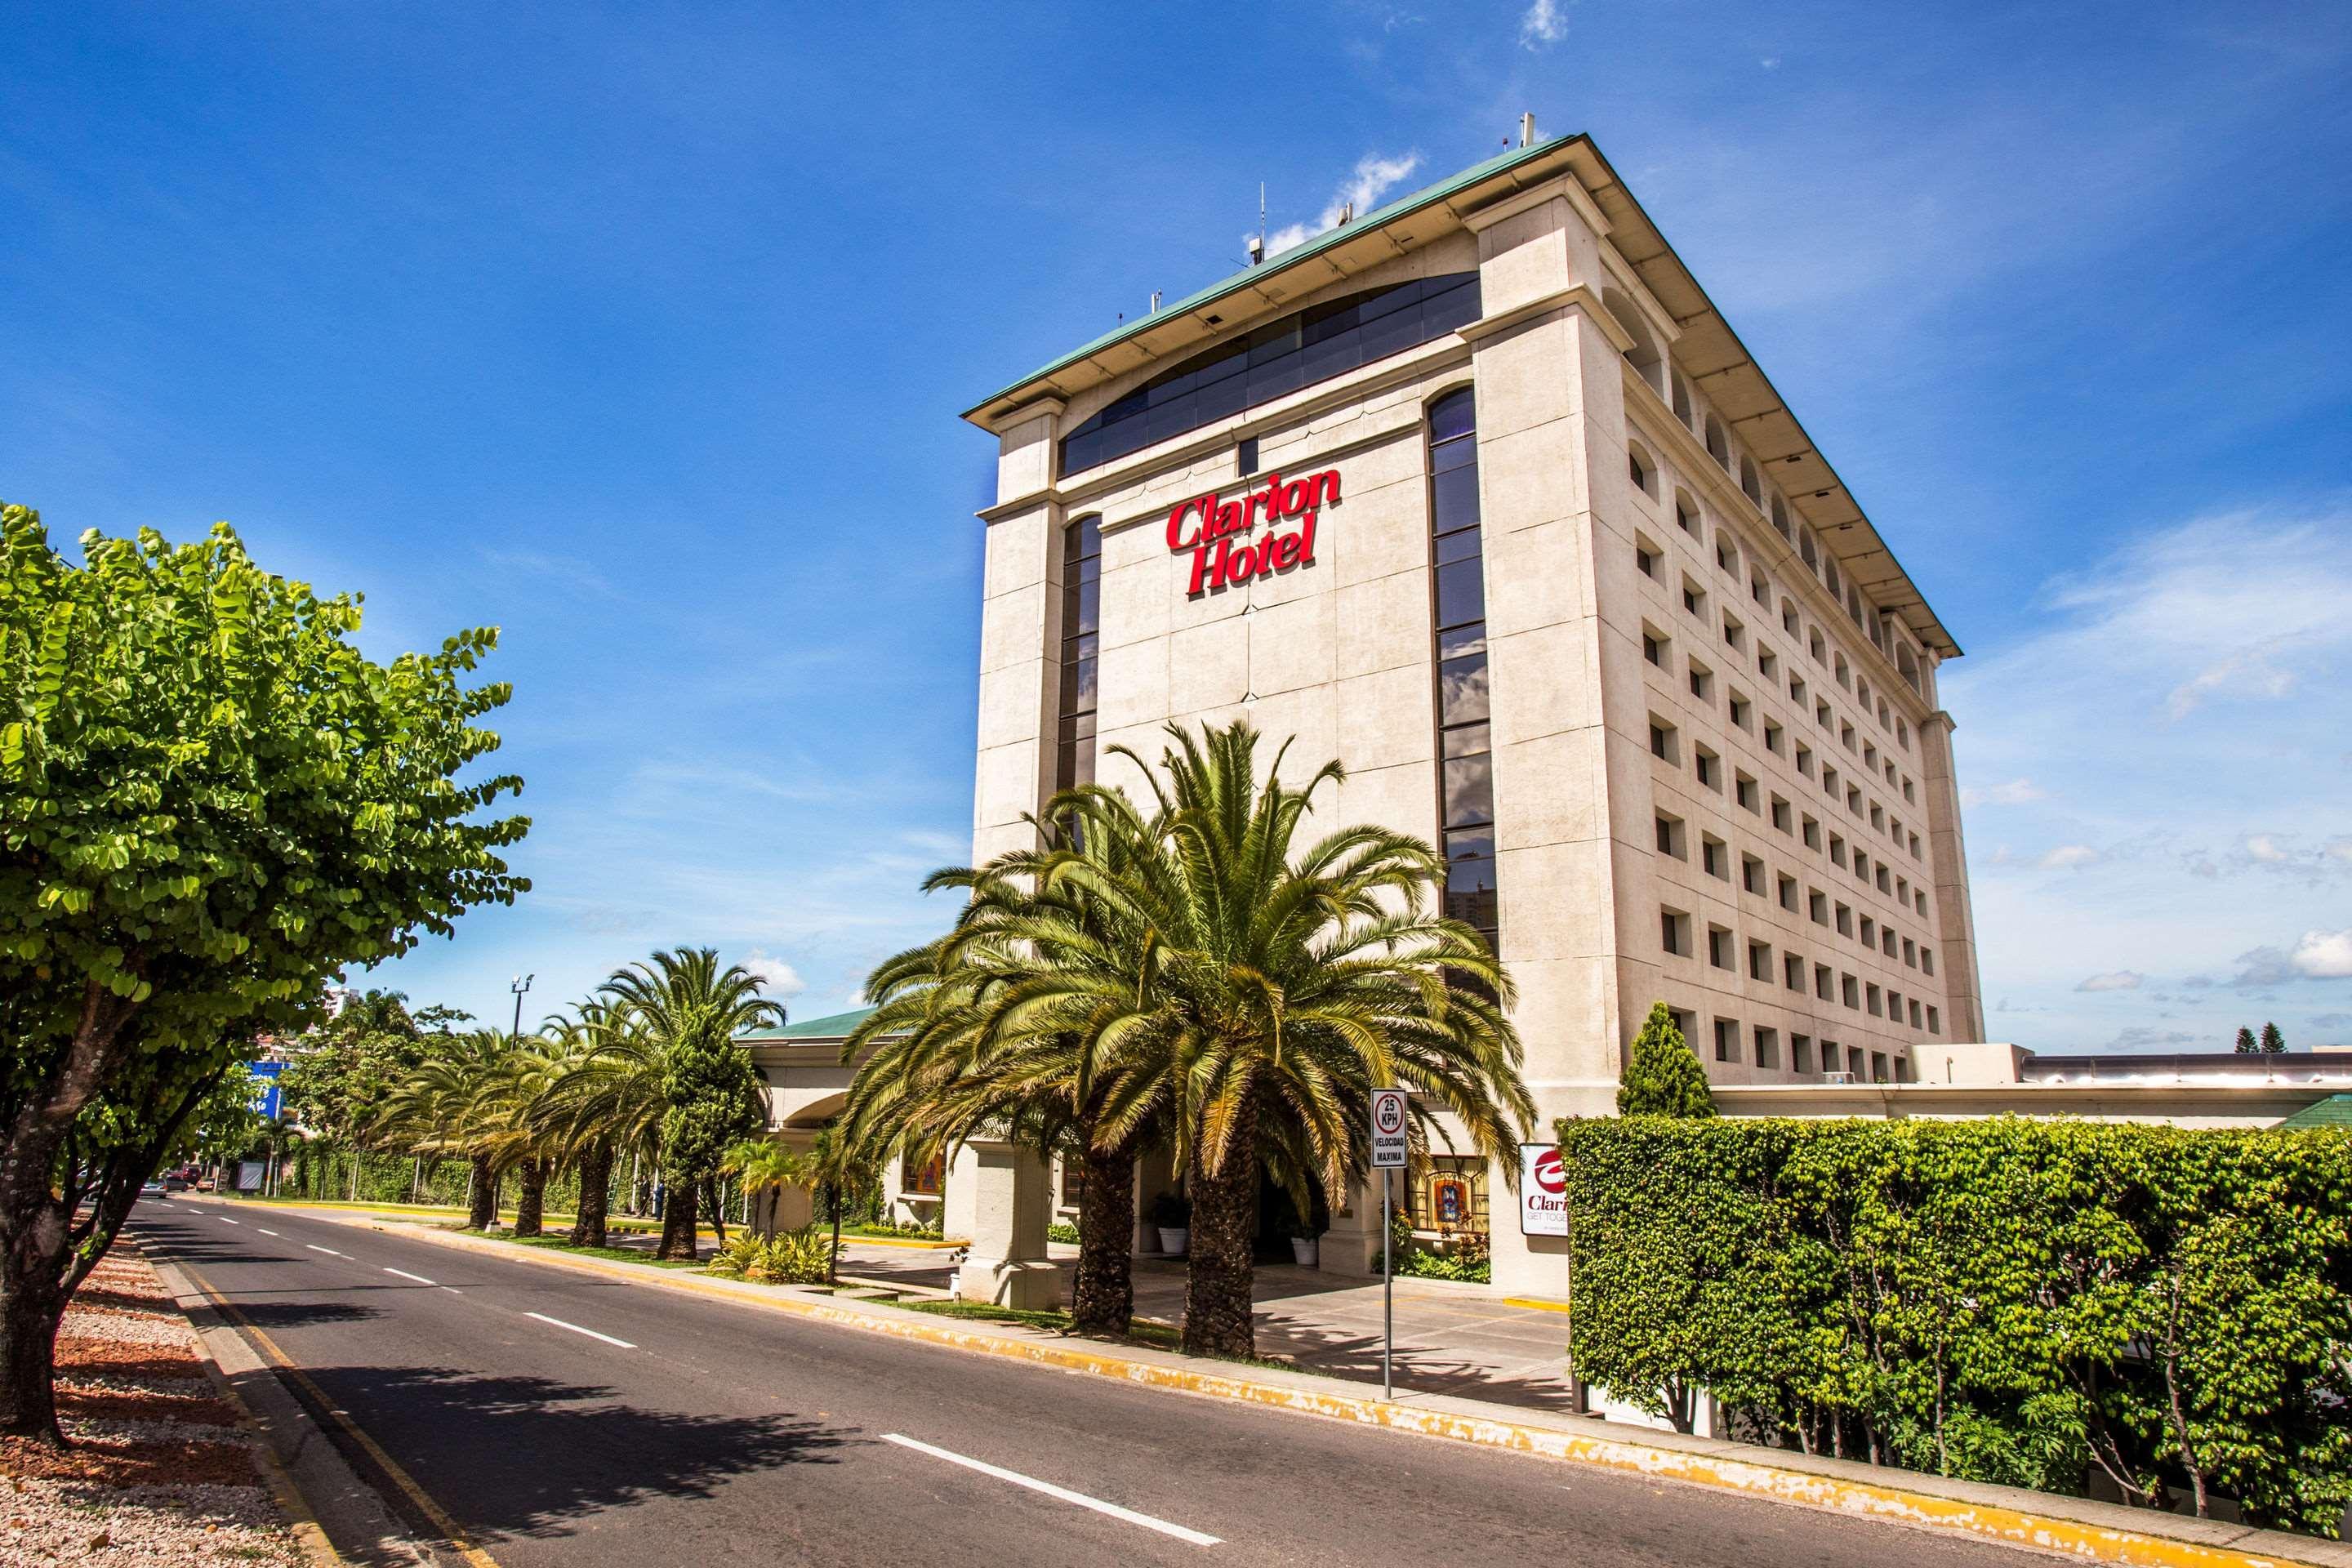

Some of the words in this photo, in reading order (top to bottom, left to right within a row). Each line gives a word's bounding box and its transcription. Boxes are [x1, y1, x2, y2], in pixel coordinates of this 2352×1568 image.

[1166, 469, 1341, 550] Clarion
[1186, 510, 1317, 595] Hotel
[1384, 1099, 1395, 1111] 25
[1381, 1113, 1398, 1125] KPH
[1374, 1137, 1404, 1147] VELOCIDAD
[1377, 1152, 1402, 1162] MAXIMA
[1527, 1212, 1543, 1220] GET
